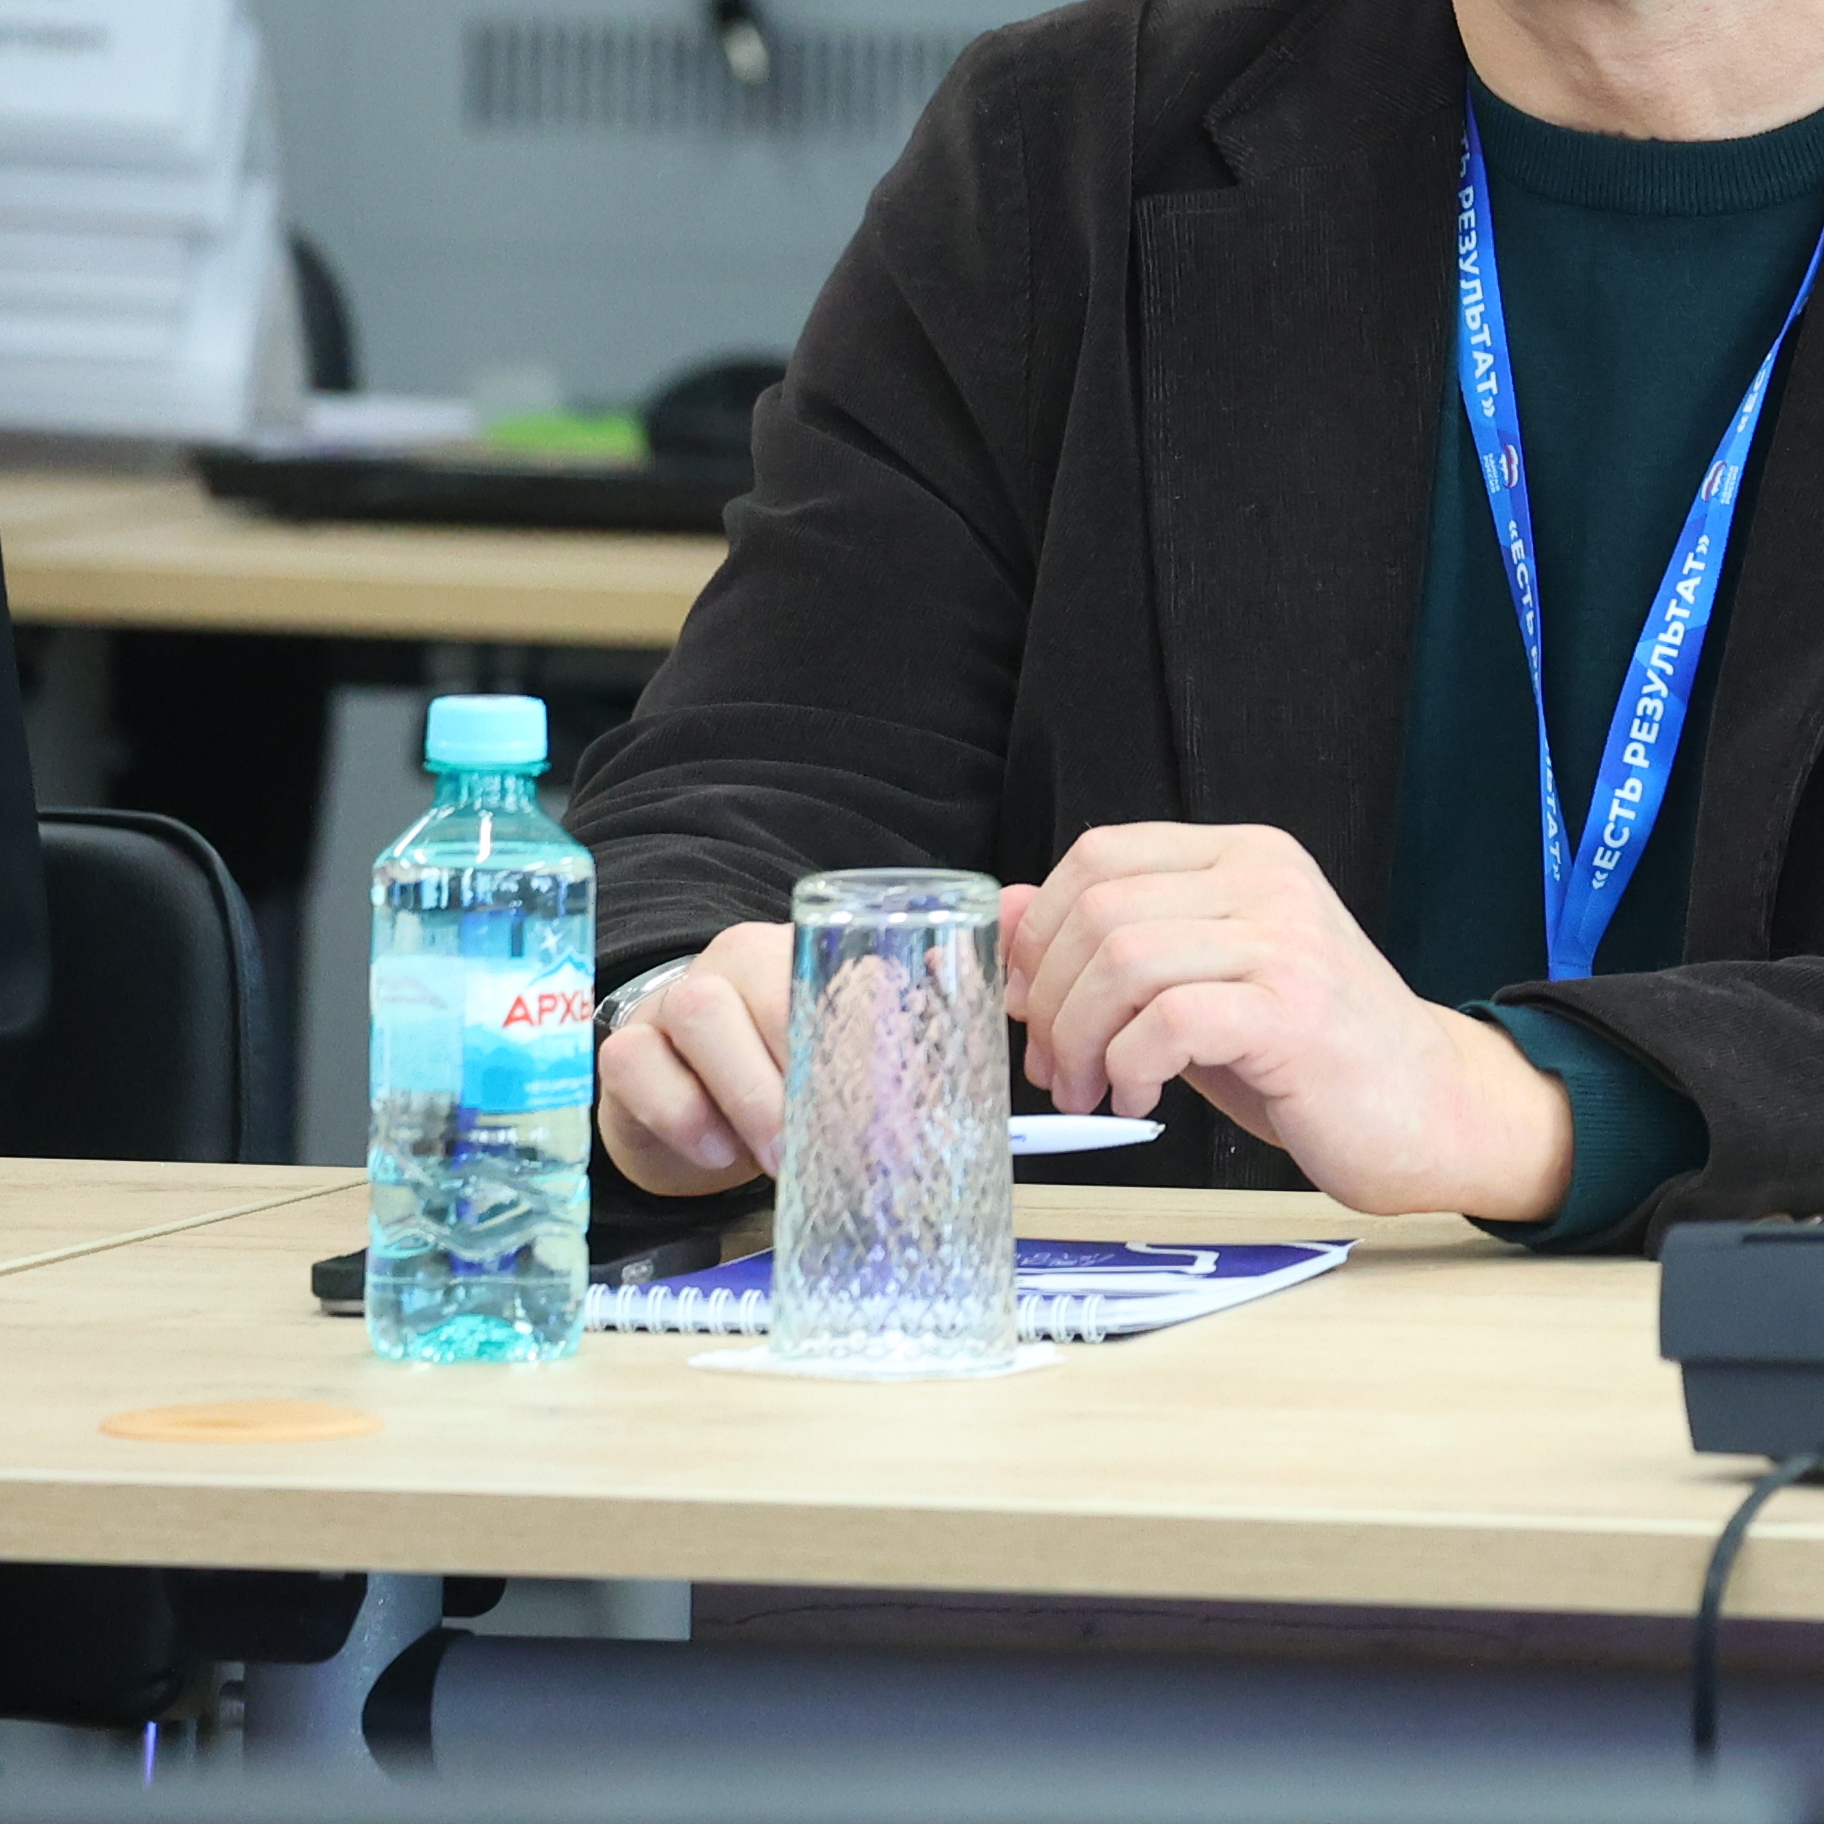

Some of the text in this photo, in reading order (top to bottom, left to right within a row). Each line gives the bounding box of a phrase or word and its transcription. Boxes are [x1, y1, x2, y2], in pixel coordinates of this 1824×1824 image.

[1508, 520, 1535, 636] «ЕСТЬ
[1592, 534, 1711, 890] «ЕСТЬ РЕЗУЛЬТАТ»
